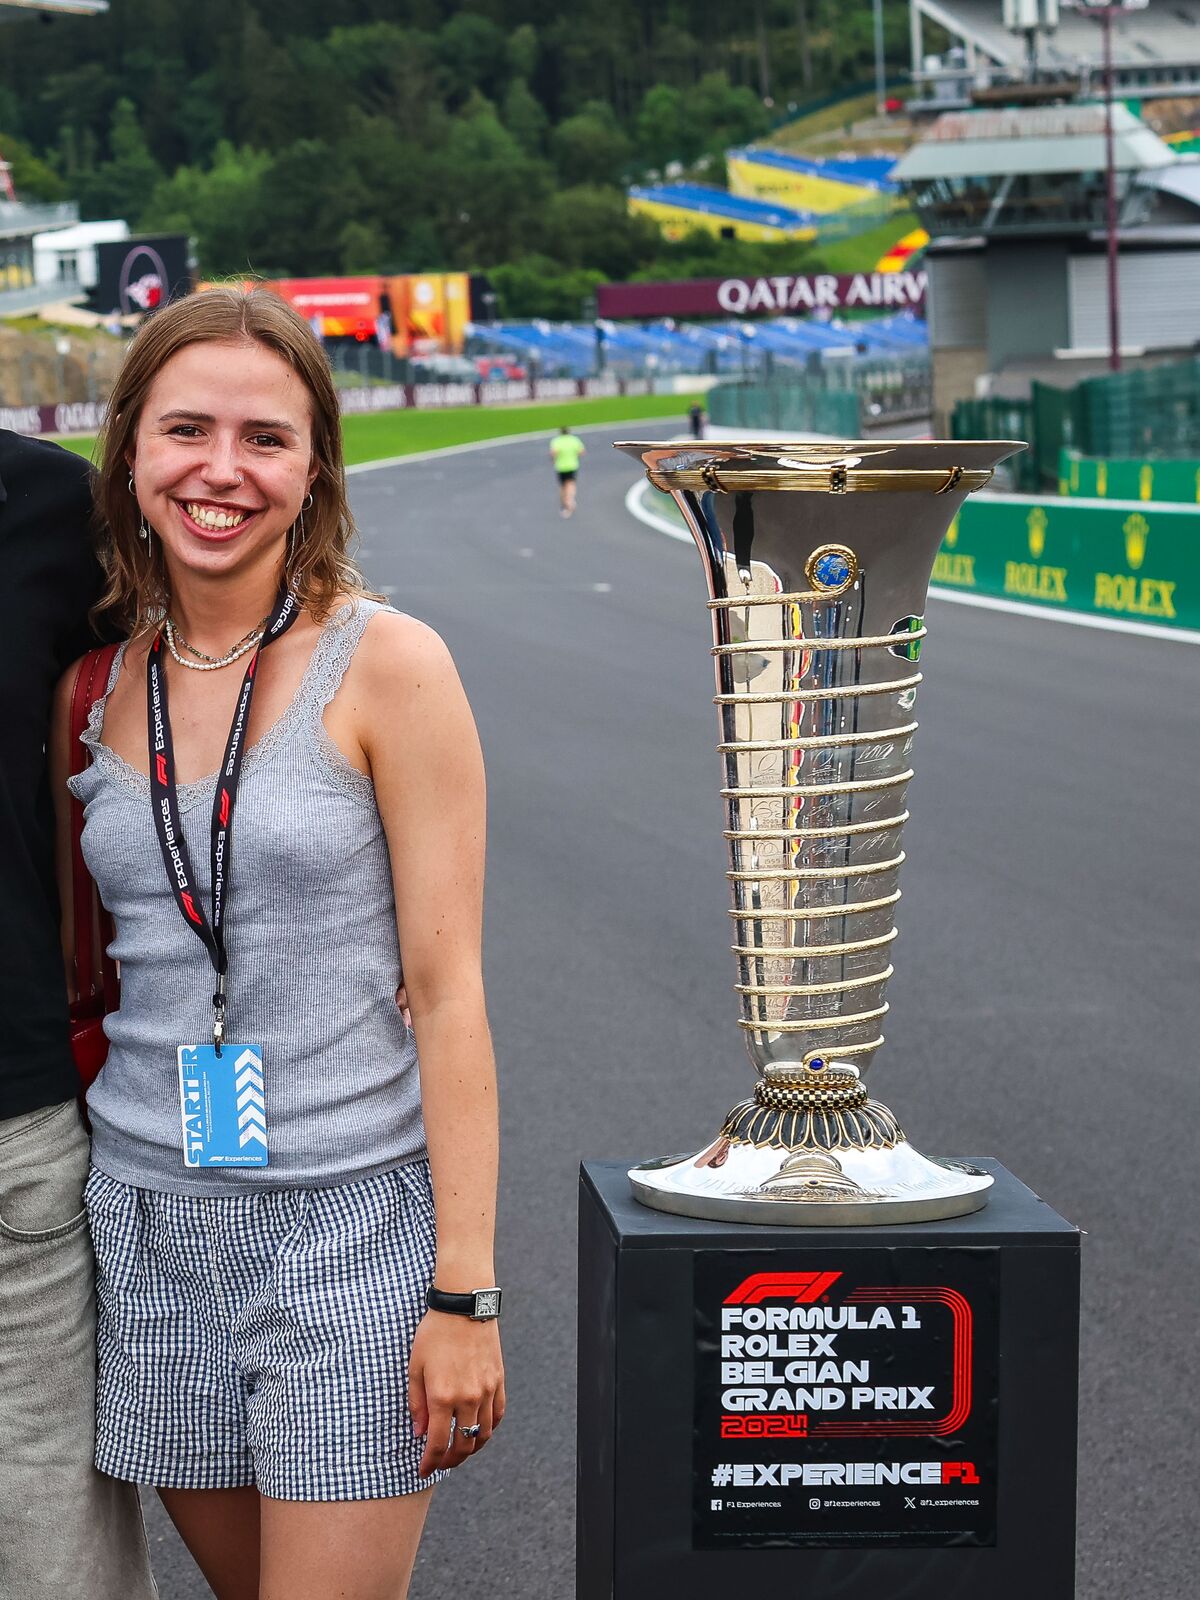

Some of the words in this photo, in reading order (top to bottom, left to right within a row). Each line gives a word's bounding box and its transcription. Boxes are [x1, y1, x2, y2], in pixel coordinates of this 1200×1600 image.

[717, 274, 840, 314] QATAR
[1005, 560, 1068, 602] ROLEX
[1095, 572, 1177, 619] ROLEX
[151, 663, 165, 752] Experiences
[225, 681, 251, 777] Experiences
[160, 797, 189, 890] Experiences
[214, 830, 226, 928] Experiences
[181, 1047, 204, 1165] STARTER
[722, 1271, 844, 1304] F1
[721, 1306, 896, 1331] FORMULA
[901, 1305, 921, 1330] 1
[721, 1333, 839, 1358] ROLEX
[721, 1360, 870, 1385] BELGIAN
[721, 1387, 846, 1411] GRAND
[851, 1386, 936, 1410] PRIX
[721, 1414, 808, 1438] 2024
[711, 1462, 981, 1487] #EXPERIENCEF1
[736, 1501, 782, 1509] Experiences
